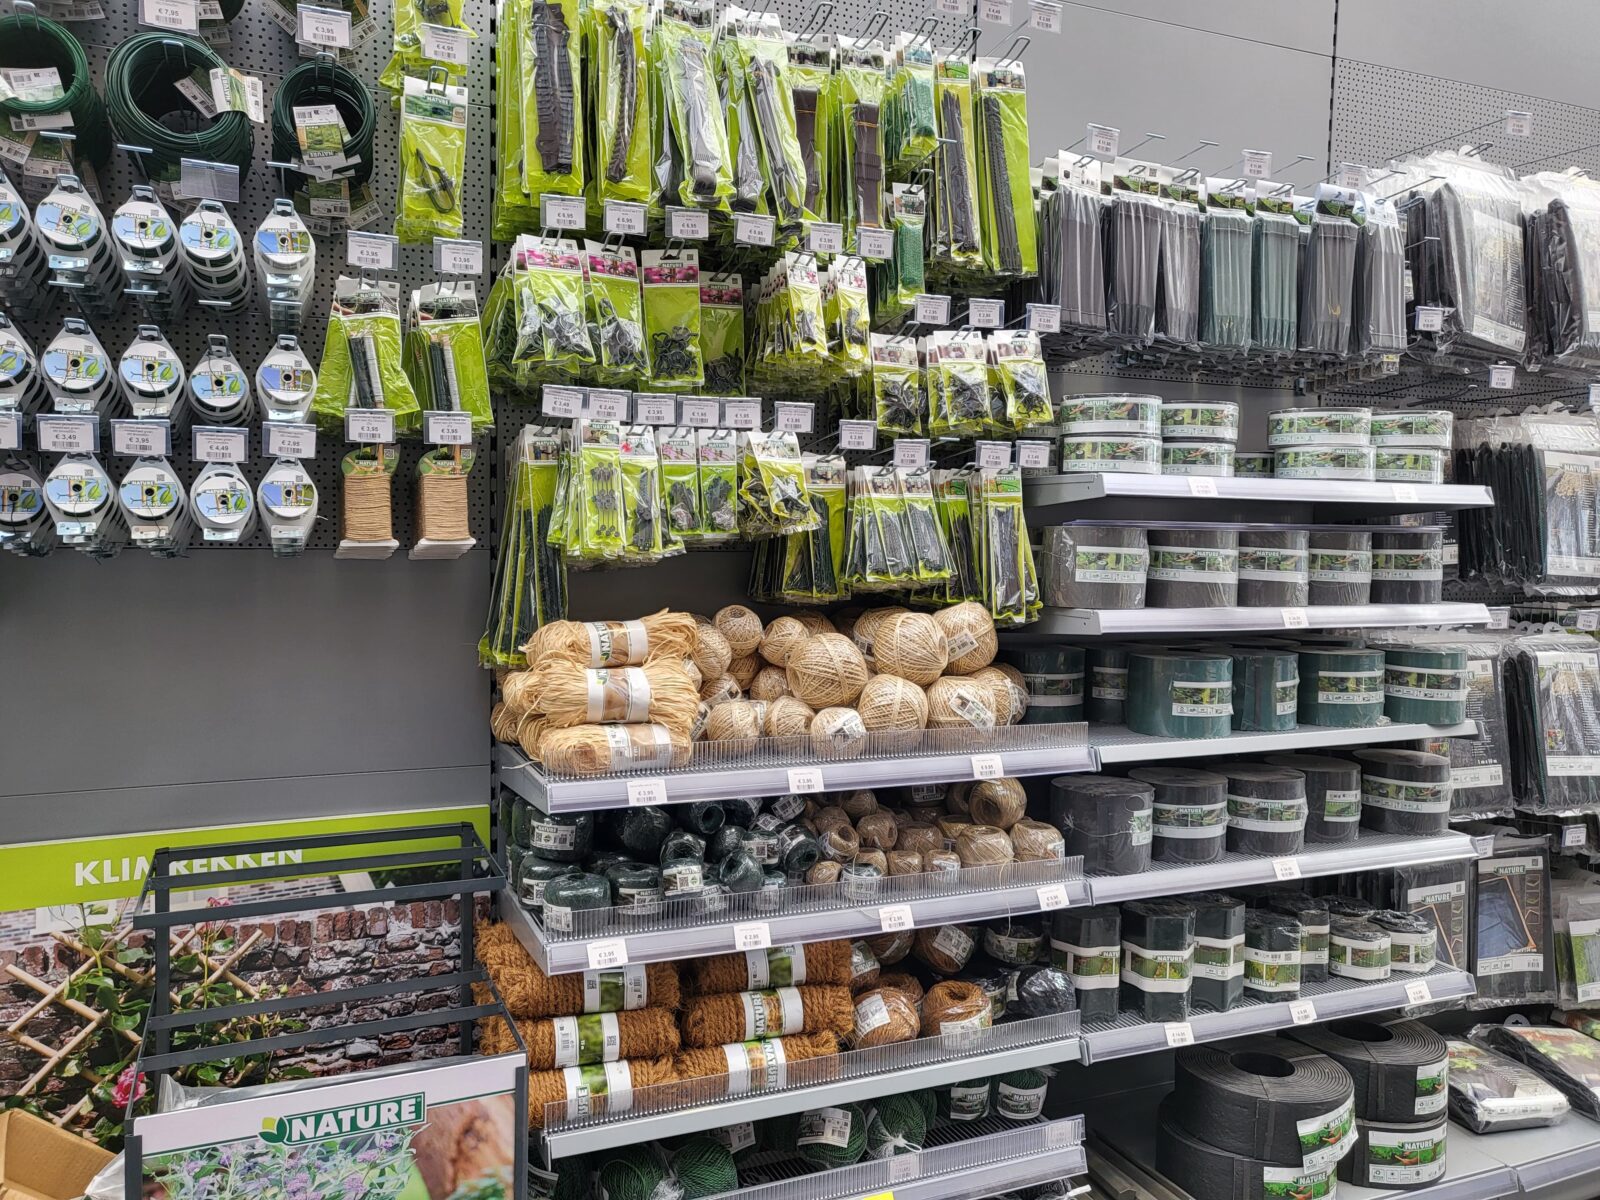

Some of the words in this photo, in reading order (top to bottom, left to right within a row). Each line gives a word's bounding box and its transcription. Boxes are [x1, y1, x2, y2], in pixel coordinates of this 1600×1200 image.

[164, 8, 180, 17] 7,95
[321, 27, 334, 35] 3,95
[538, 825, 558, 833] NATURE
[1499, 865, 1524, 874] NATURE
[702, 884, 719, 895] ATURE
[1426, 893, 1450, 903] NATURE
[1250, 978, 1275, 987] NATURE
[751, 992, 765, 1035] NATURE
[764, 1041, 778, 1089] NATURE
[291, 1097, 416, 1142] NATURE
[1405, 1140, 1433, 1150] NATURE
[1299, 1172, 1327, 1185] NATURE
